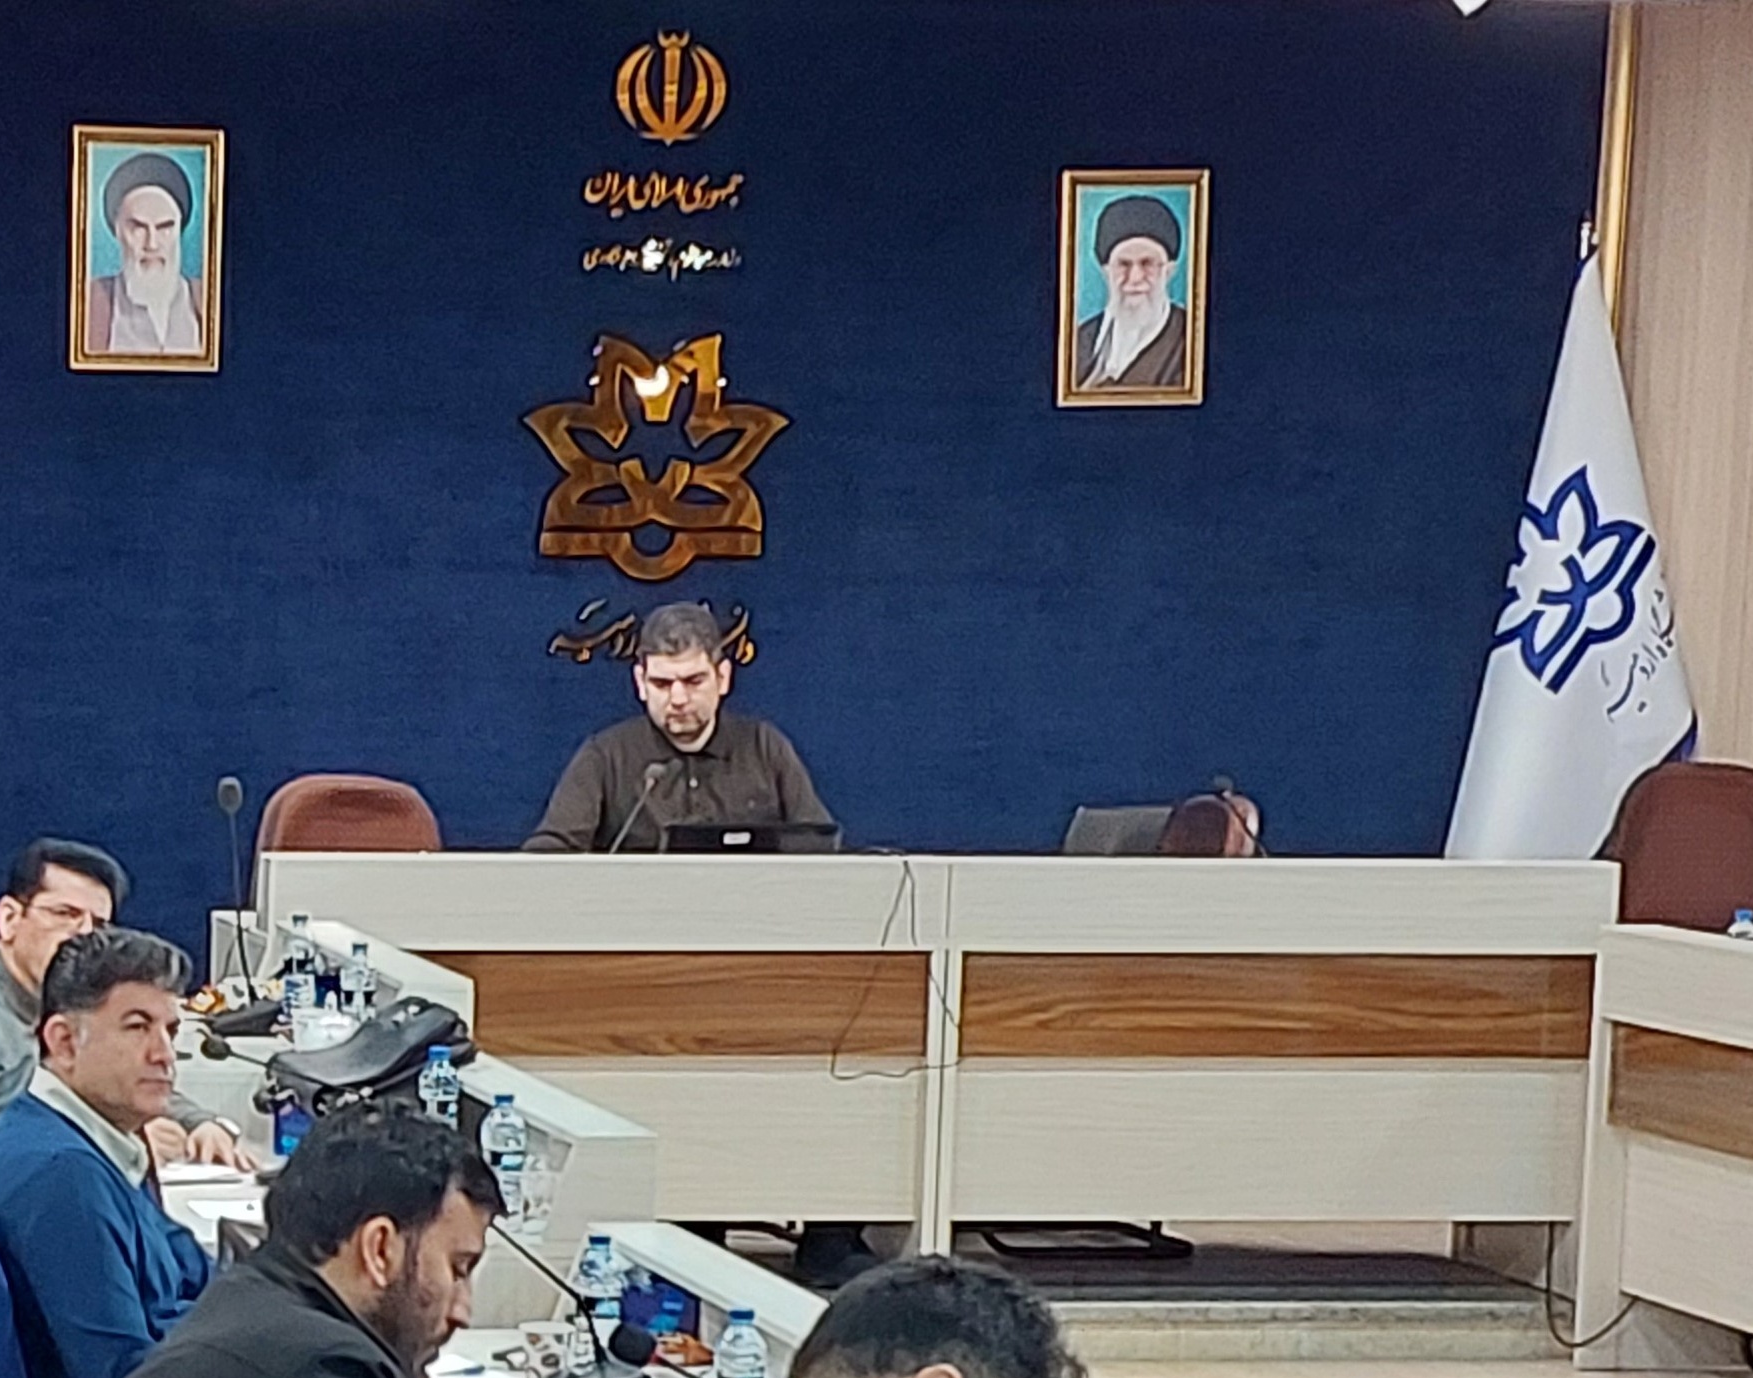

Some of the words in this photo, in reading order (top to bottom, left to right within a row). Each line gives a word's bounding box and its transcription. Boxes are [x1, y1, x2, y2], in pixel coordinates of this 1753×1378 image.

[584, 172, 635, 219] ایران
[628, 170, 685, 211] اسلامی
[679, 173, 745, 214] جمهوری
